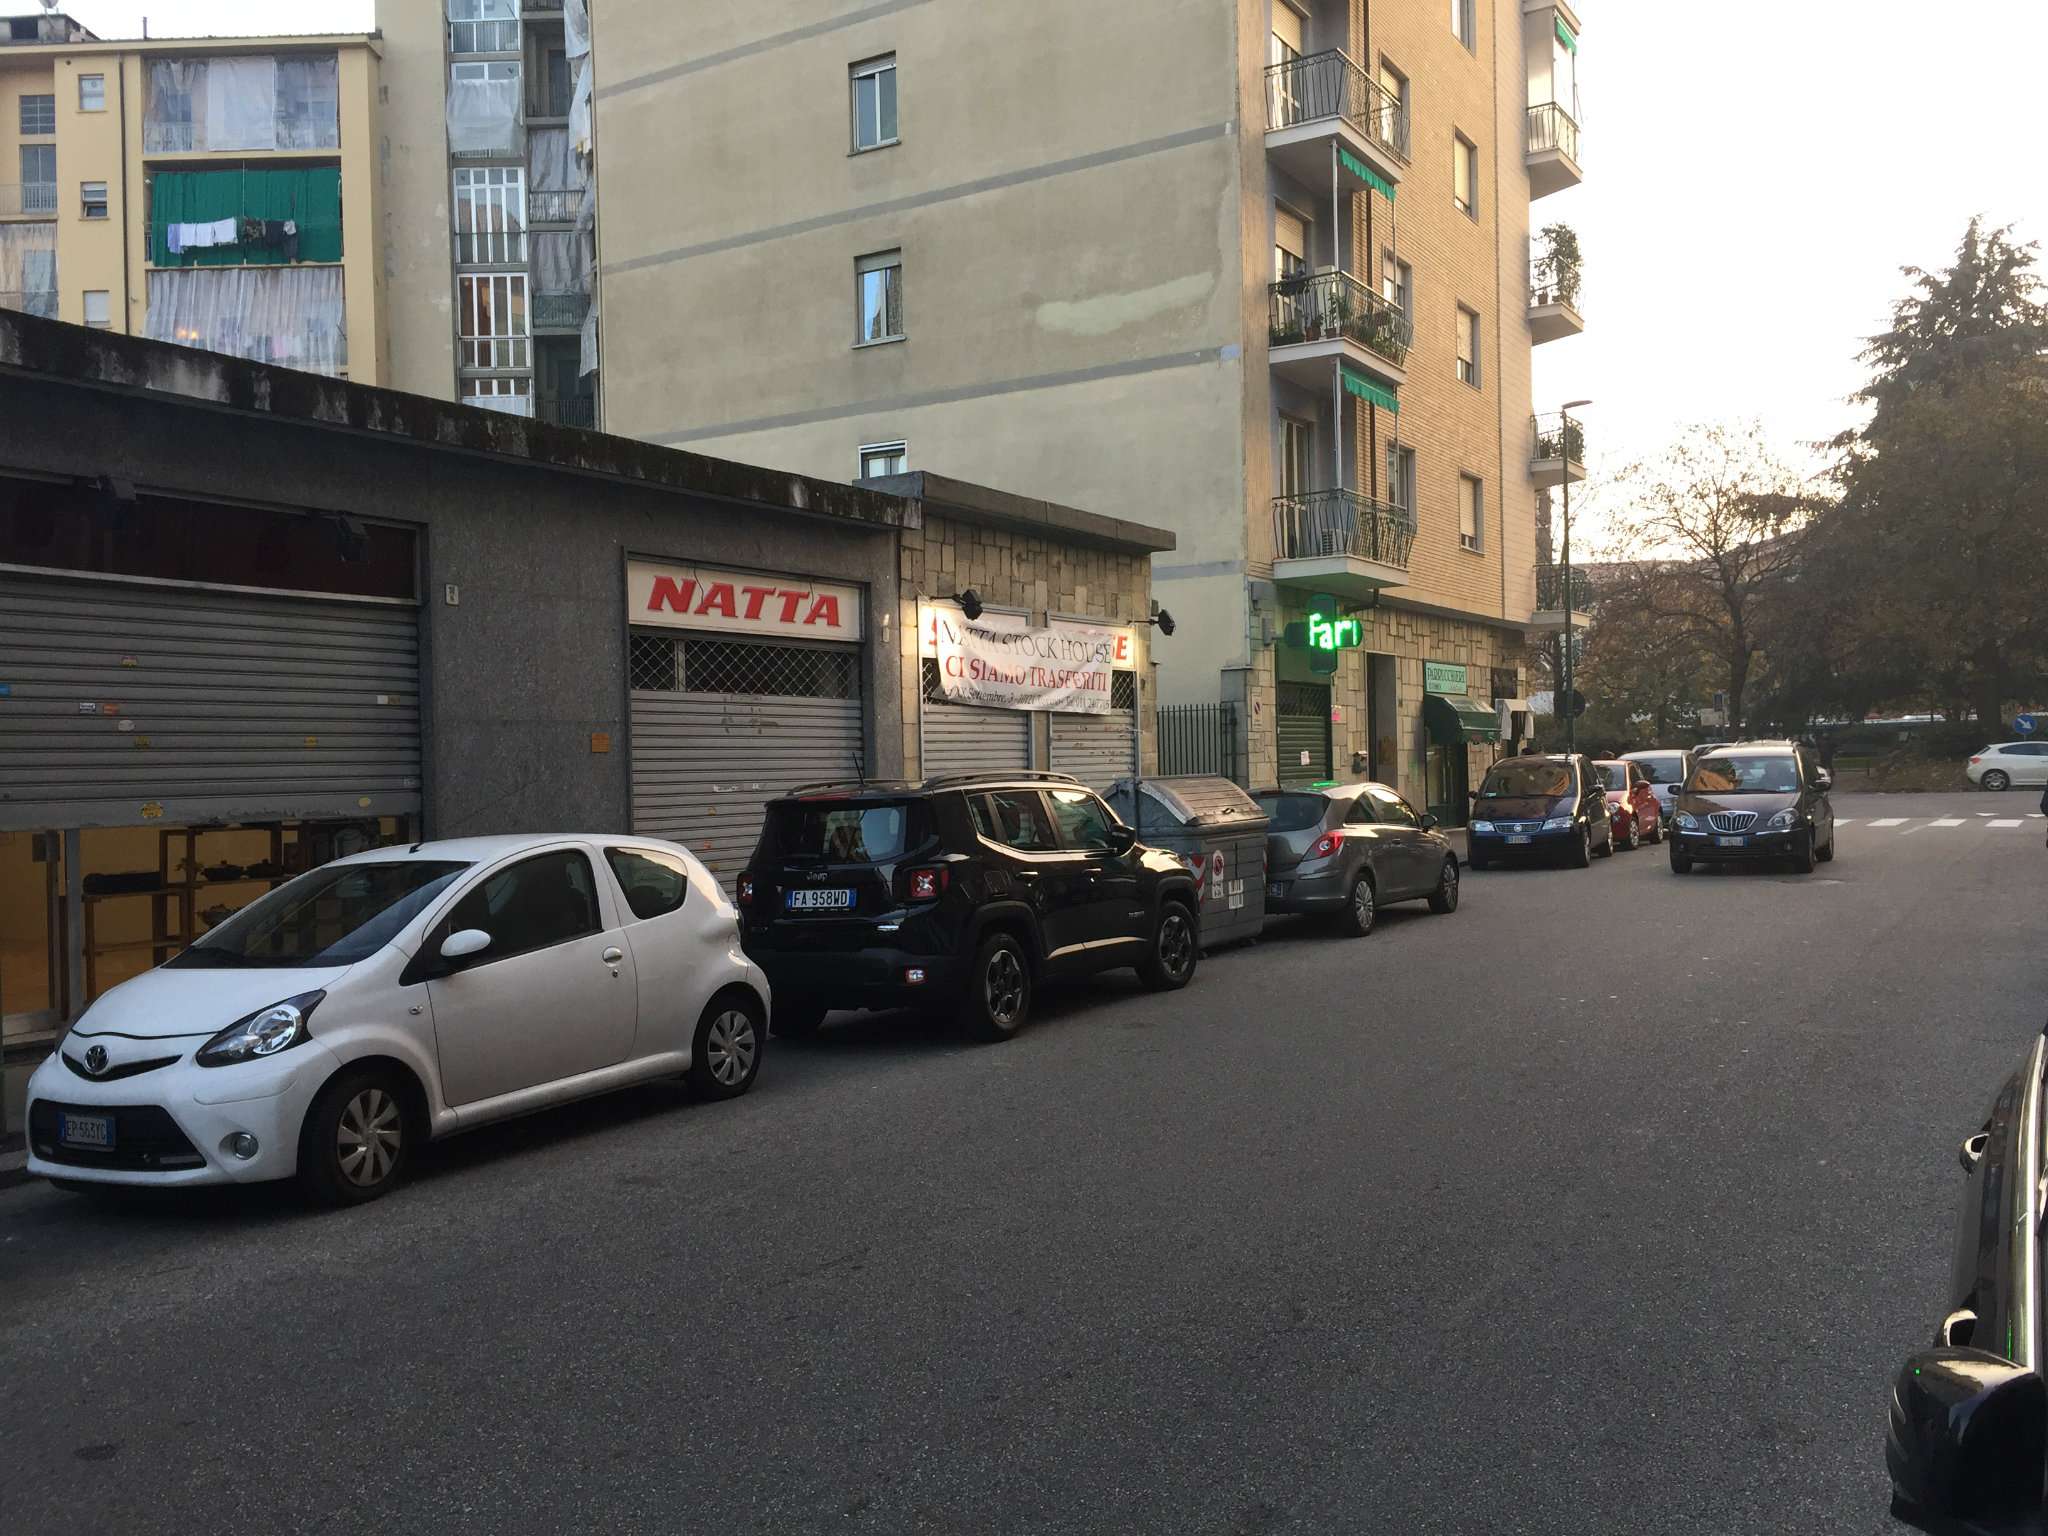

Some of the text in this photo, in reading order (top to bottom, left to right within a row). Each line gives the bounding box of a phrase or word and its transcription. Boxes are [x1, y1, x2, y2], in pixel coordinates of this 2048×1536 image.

[647, 575, 842, 628] NATTA
[941, 619, 999, 653] NATTA
[1001, 631, 1058, 660] STOCK
[1061, 639, 1112, 665] HOUSE
[1309, 612, 1359, 650] Far
[944, 655, 1108, 692] CI SIAMO TRASFERITI
[793, 890, 848, 906] FA 958WD
[67, 1120, 78, 1137] EP
